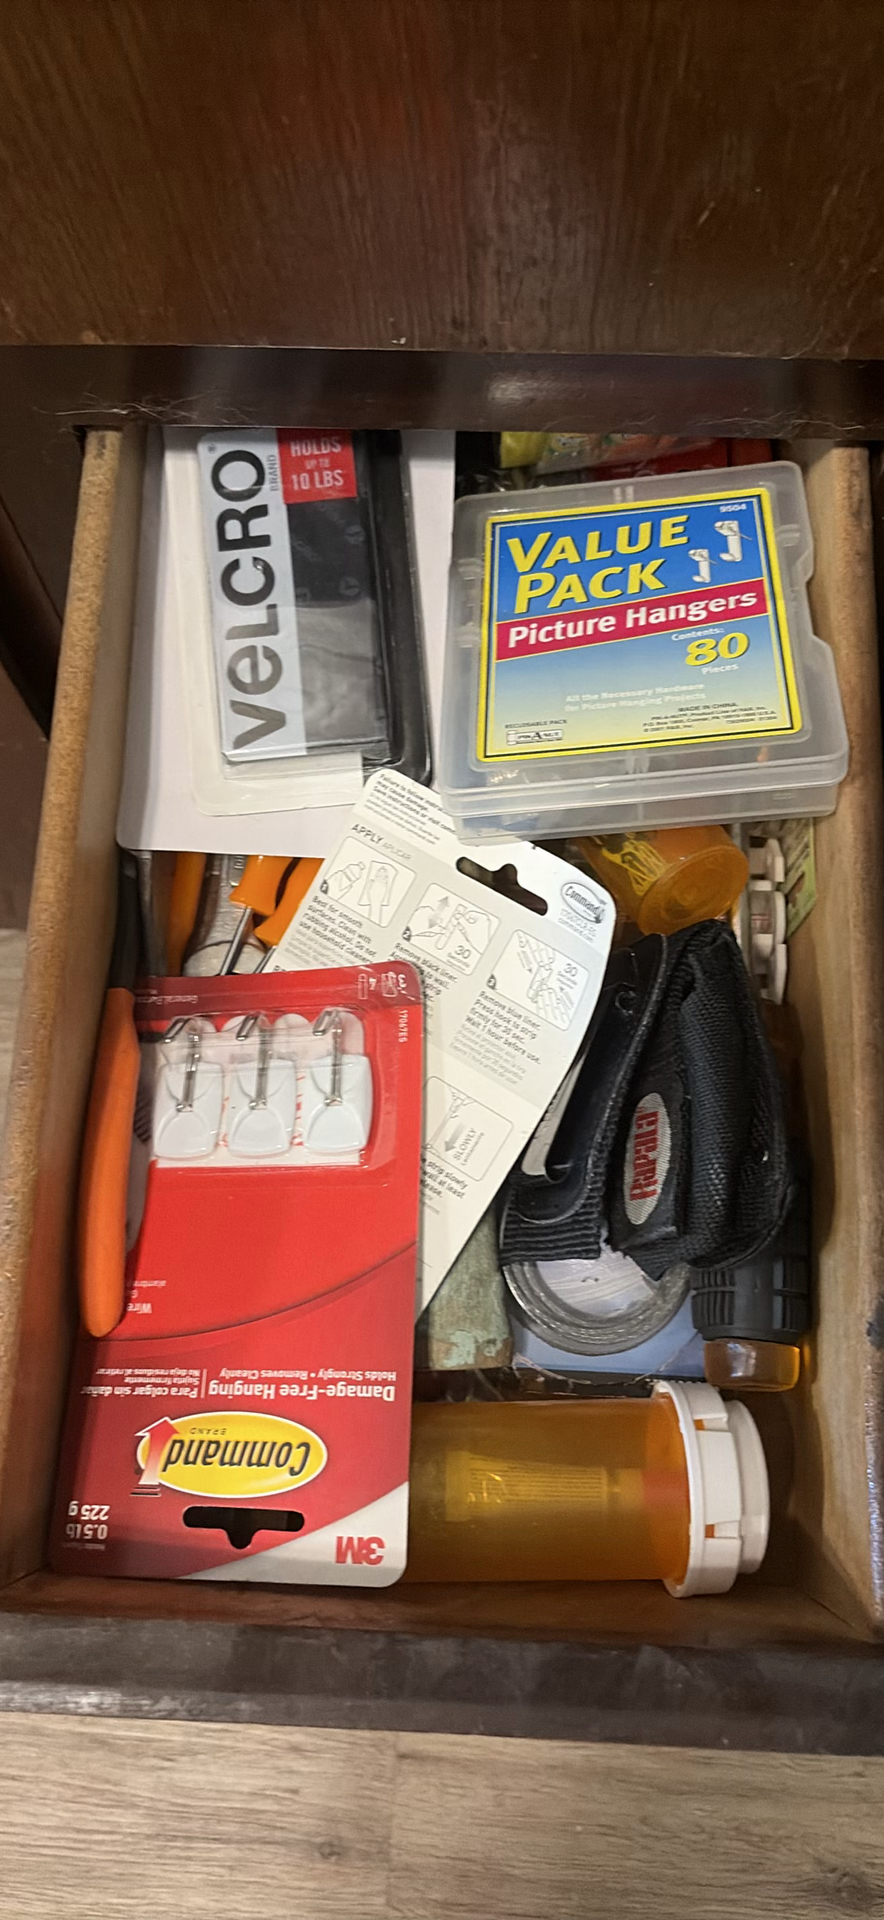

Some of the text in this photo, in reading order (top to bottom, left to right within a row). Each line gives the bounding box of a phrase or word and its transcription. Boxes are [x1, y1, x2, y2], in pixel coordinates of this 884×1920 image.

[290, 436, 342, 457] HOLDS
[266, 454, 279, 492] BRAND
[292, 469, 343, 490] 10 LBS
[719, 503, 747, 513] 9504
[508, 592, 757, 648] Picture Hangers
[671, 626, 725, 642] Contents:
[685, 632, 749, 667] 80
[702, 662, 739, 675] Pieces
[582, 702, 617, 710] Picture
[618, 698, 662, 707] Hanging
[663, 693, 706, 702] Projects
[600, 689, 654, 699] Necessary
[655, 684, 704, 694] Hardware
[375, 780, 389, 791] may
[389, 787, 406, 799] cause
[379, 773, 401, 788] Failure
[399, 784, 407, 792] to
[406, 788, 425, 802] follow
[372, 785, 388, 797] Save
[387, 793, 421, 815] instructions
[427, 815, 440, 826] visit
[351, 822, 384, 846] APPLY
[565, 885, 601, 915] Command
[312, 895, 364, 929] Best for smooth
[307, 903, 372, 944] surfaces. Clean with
[298, 920, 312, 931] use
[310, 926, 346, 951] household
[301, 911, 330, 932] rubbing
[328, 926, 356, 945] alcohol.
[354, 940, 366, 951] Do
[364, 946, 378, 958] not
[394, 941, 422, 962] Remove
[421, 957, 441, 973] black
[439, 968, 460, 984] liner.
[456, 945, 471, 959] 30
[564, 963, 578, 977] 30
[433, 976, 452, 991] wall.
[473, 998, 538, 1042] Press hook to strip
[478, 990, 543, 1032] Remove blue liner.
[468, 1006, 492, 1026] firmly
[490, 1018, 503, 1030] for
[511, 1032, 528, 1045] sec.
[464, 1016, 482, 1030] Wait
[485, 1028, 504, 1043] hour
[502, 1037, 528, 1056] before
[525, 1052, 543, 1066] use.
[452, 1127, 477, 1161] SLOWLY
[438, 1179, 447, 1187] at
[445, 1183, 466, 1199] least
[445, 1168, 468, 1191] slowly
[127, 1302, 152, 1314] Wire
[96, 1368, 124, 1376] retirar
[124, 1376, 200, 1385] Sujeta firmemente
[170, 1368, 187, 1376] deja
[219, 1368, 397, 1381] Holds Strongly Removes Cleanly
[80, 1384, 198, 1398] Para colgar sin dañar
[208, 1379, 396, 1401] Damage-Free Hanging
[189, 1426, 228, 1436] BRAND
[162, 1438, 311, 1477] Command
[67, 1500, 110, 1520] 225 g
[65, 1523, 108, 1539] 0.5 lb
[335, 1536, 385, 1566] 3M
